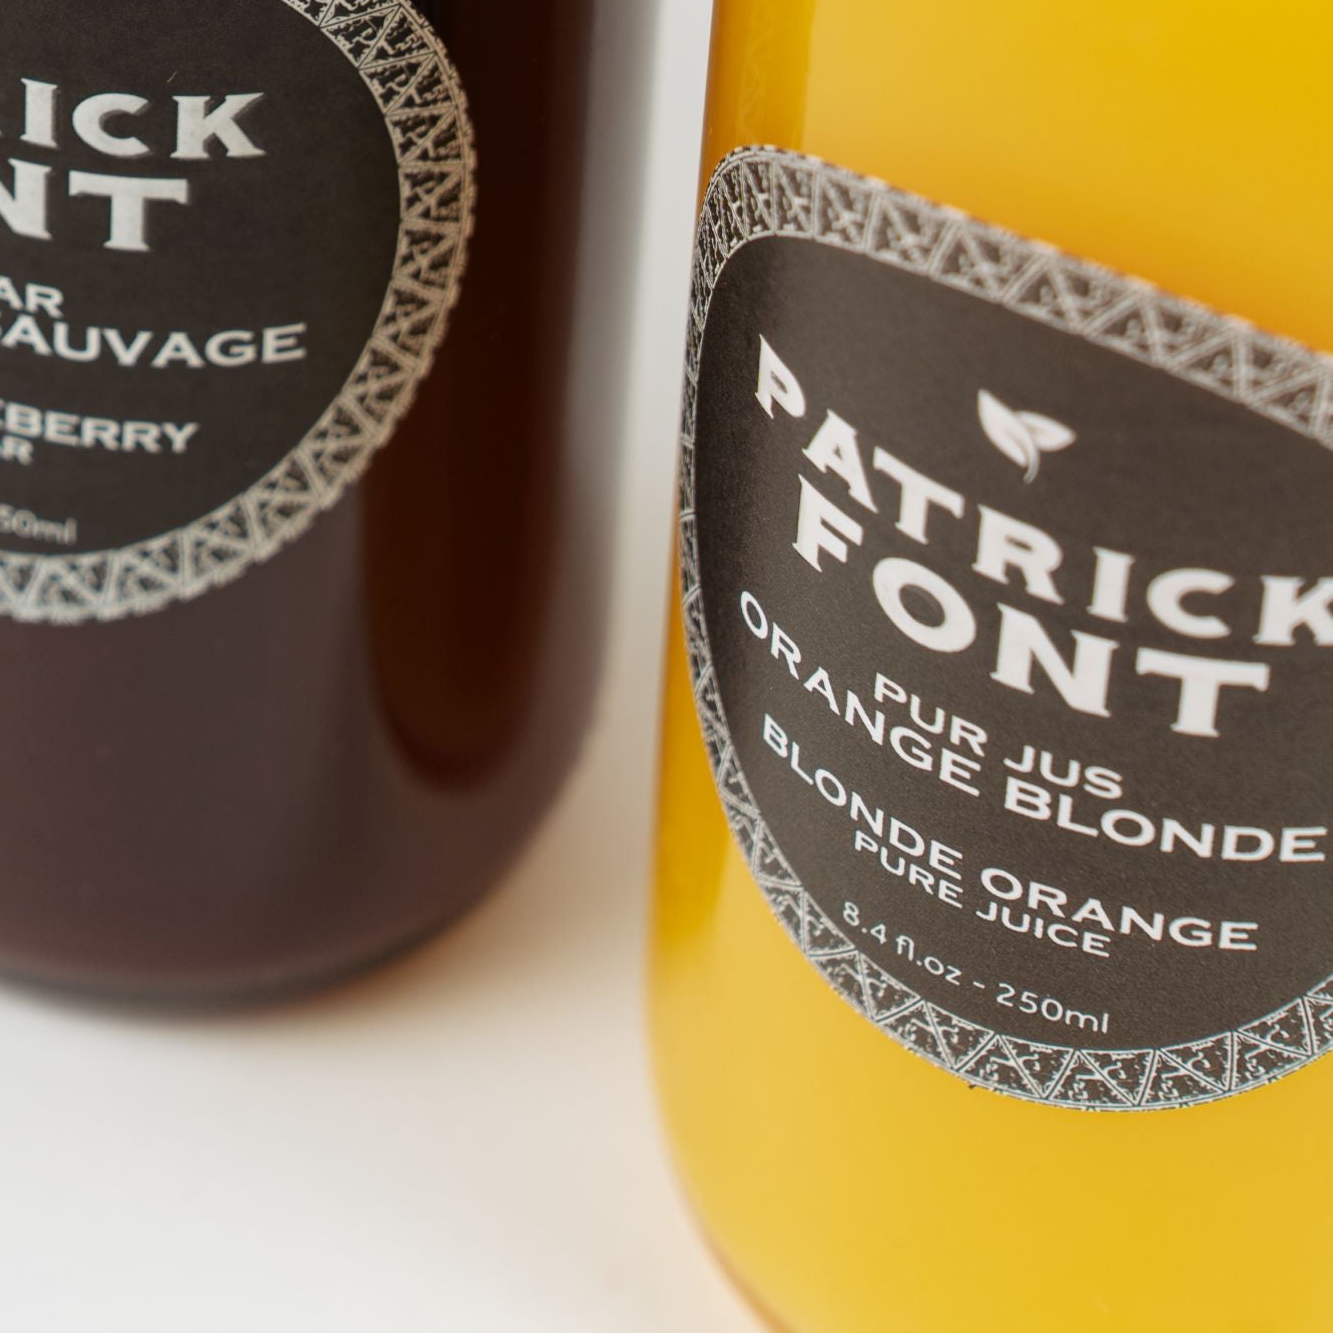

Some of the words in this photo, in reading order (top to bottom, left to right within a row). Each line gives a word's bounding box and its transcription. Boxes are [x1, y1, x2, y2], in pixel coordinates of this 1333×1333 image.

[755, 333, 1333, 647] PATRICK
[792, 473, 1271, 738] FONT
[739, 590, 982, 797] ORANGE
[1003, 776, 1328, 864] BLONDE
[762, 713, 964, 881] BLONDE
[980, 866, 1259, 952] ORANGE
[873, 671, 989, 758] PUR
[1003, 744, 1124, 800] JUS
[842, 900, 888, 946] 8.4
[895, 934, 964, 986] fl.oz
[995, 982, 1110, 1035] 250ml
[853, 832, 964, 910] PURE
[975, 901, 1112, 959] JUICE
